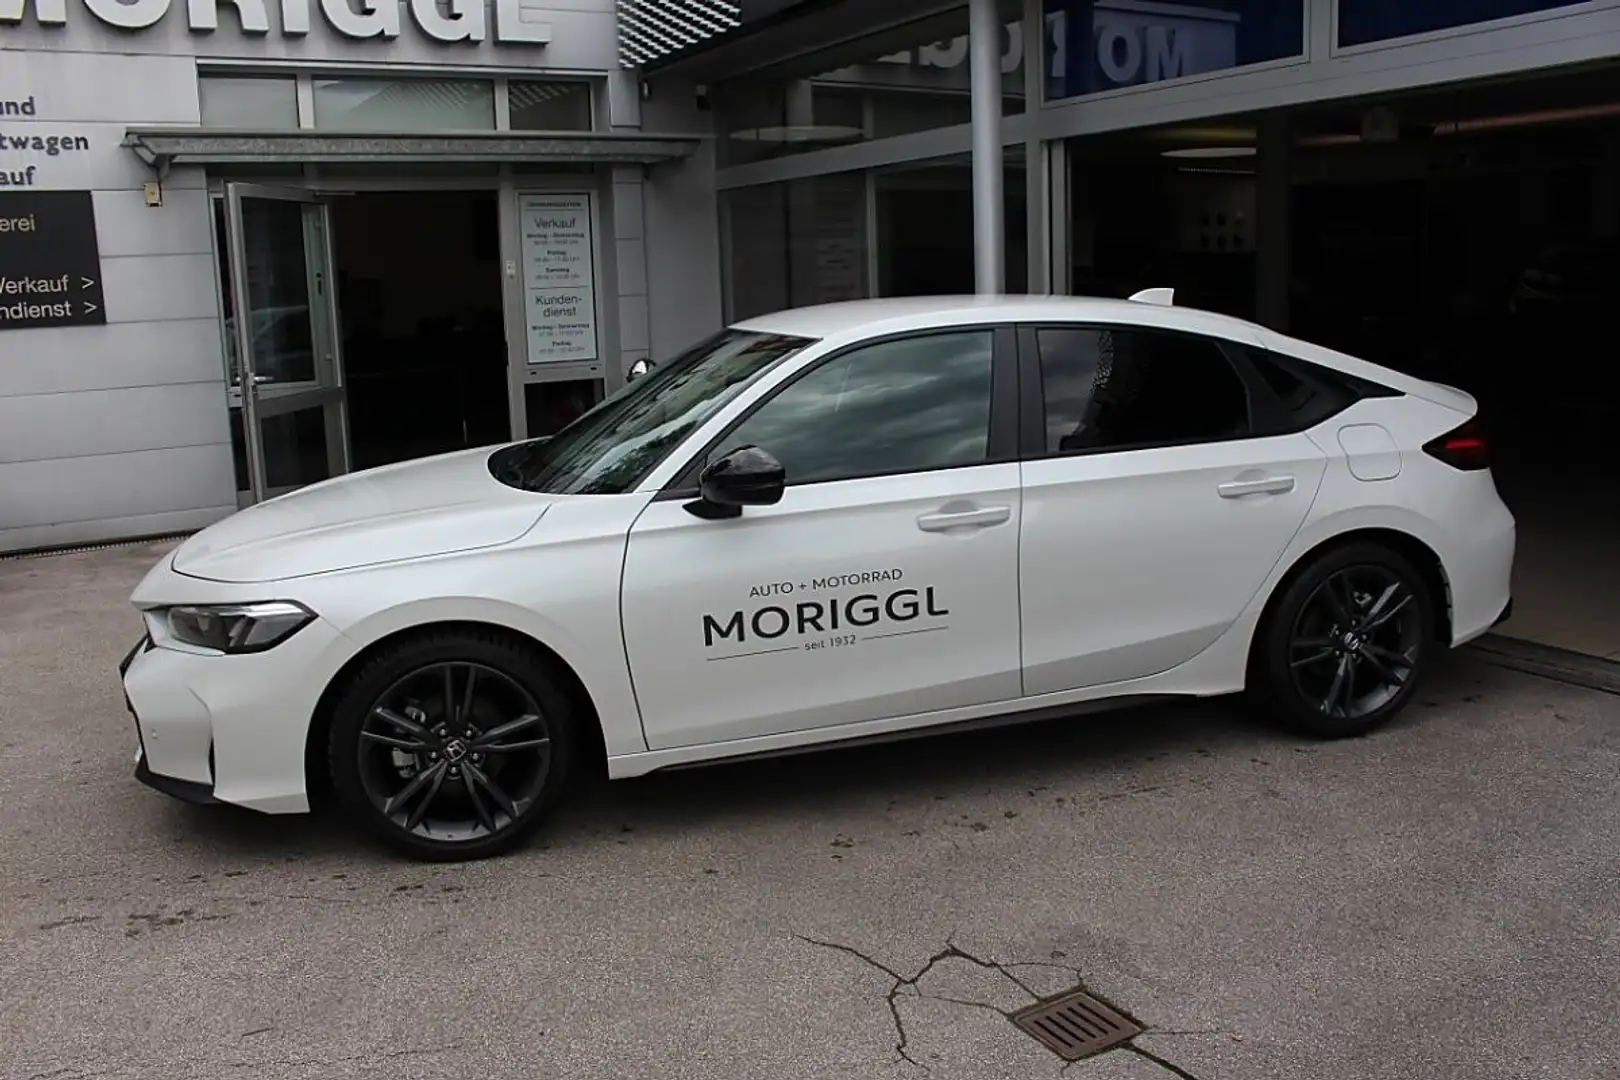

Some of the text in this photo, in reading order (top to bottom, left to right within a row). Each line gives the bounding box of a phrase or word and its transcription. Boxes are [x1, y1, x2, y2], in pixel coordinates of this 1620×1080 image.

[534, 216, 576, 229] Verkauf
[535, 295, 582, 305] Kunden-
[543, 306, 577, 317] dienst
[749, 568, 903, 598] AUTO + MOTORRAD
[702, 586, 949, 647] MORIGGL
[804, 635, 856, 650] seit 1932
